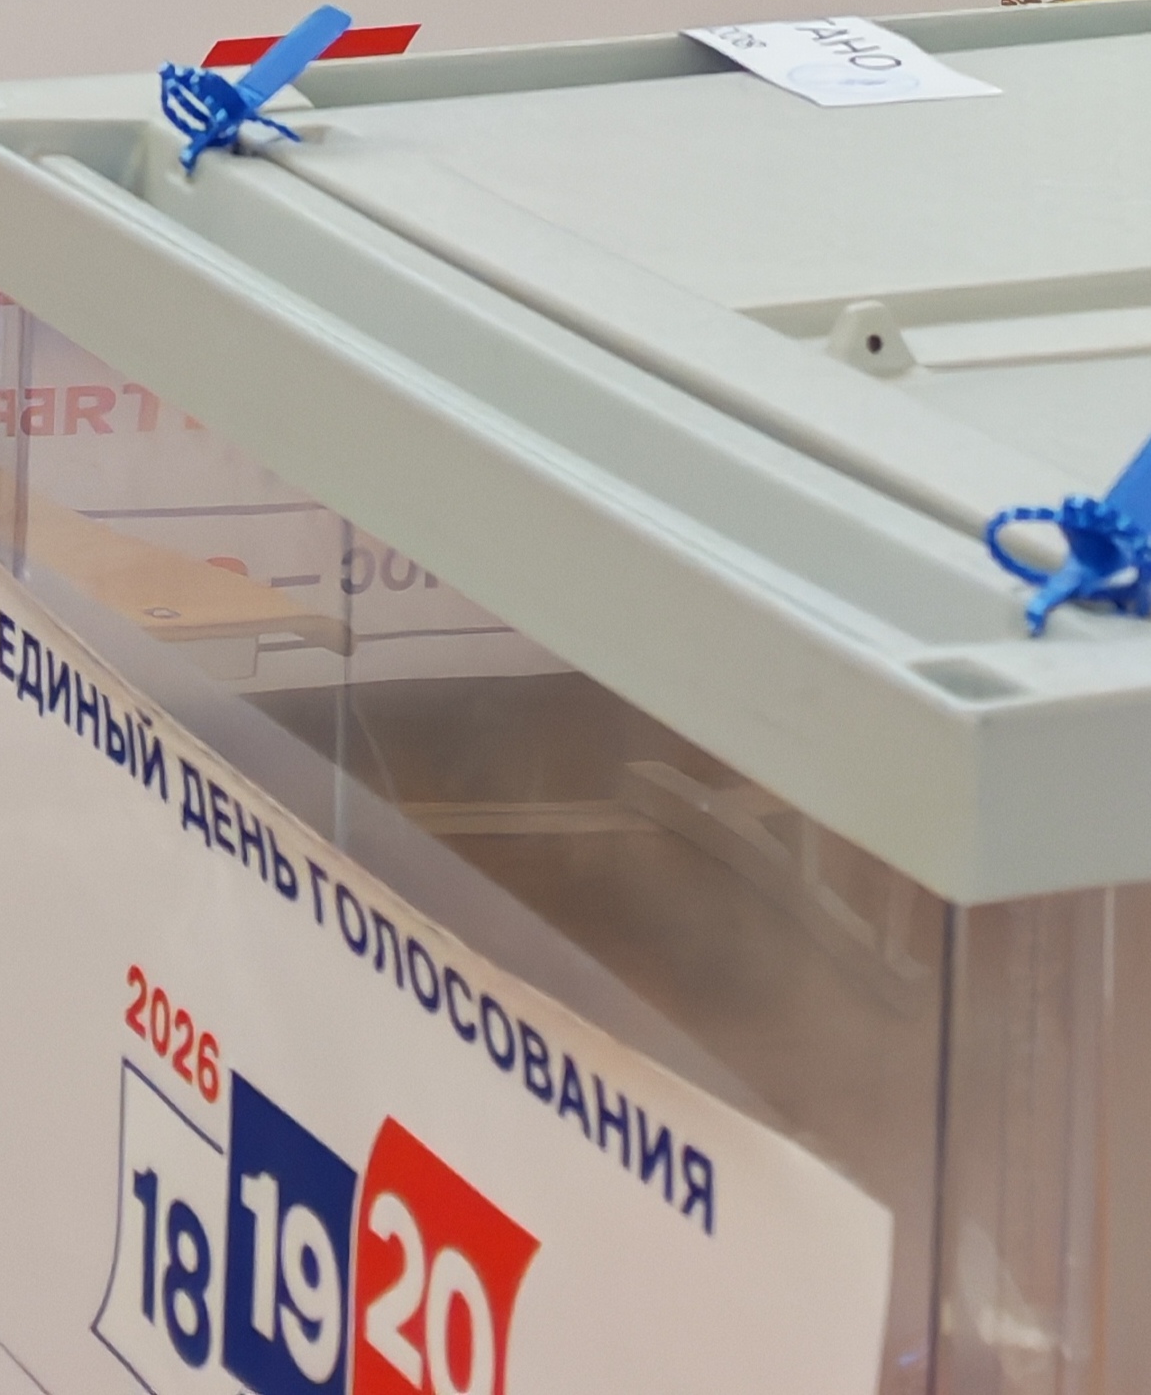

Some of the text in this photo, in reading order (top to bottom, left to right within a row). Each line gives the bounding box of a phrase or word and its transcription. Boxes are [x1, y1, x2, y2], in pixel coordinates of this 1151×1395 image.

[795, 18, 902, 70] АНО
[125, 963, 220, 1104] 2026
[177, 757, 299, 901] ДЕНЬ
[304, 855, 714, 1236] ГОЛОСОВАНИЯ
[133, 1166, 496, 1395] 18 19 20
